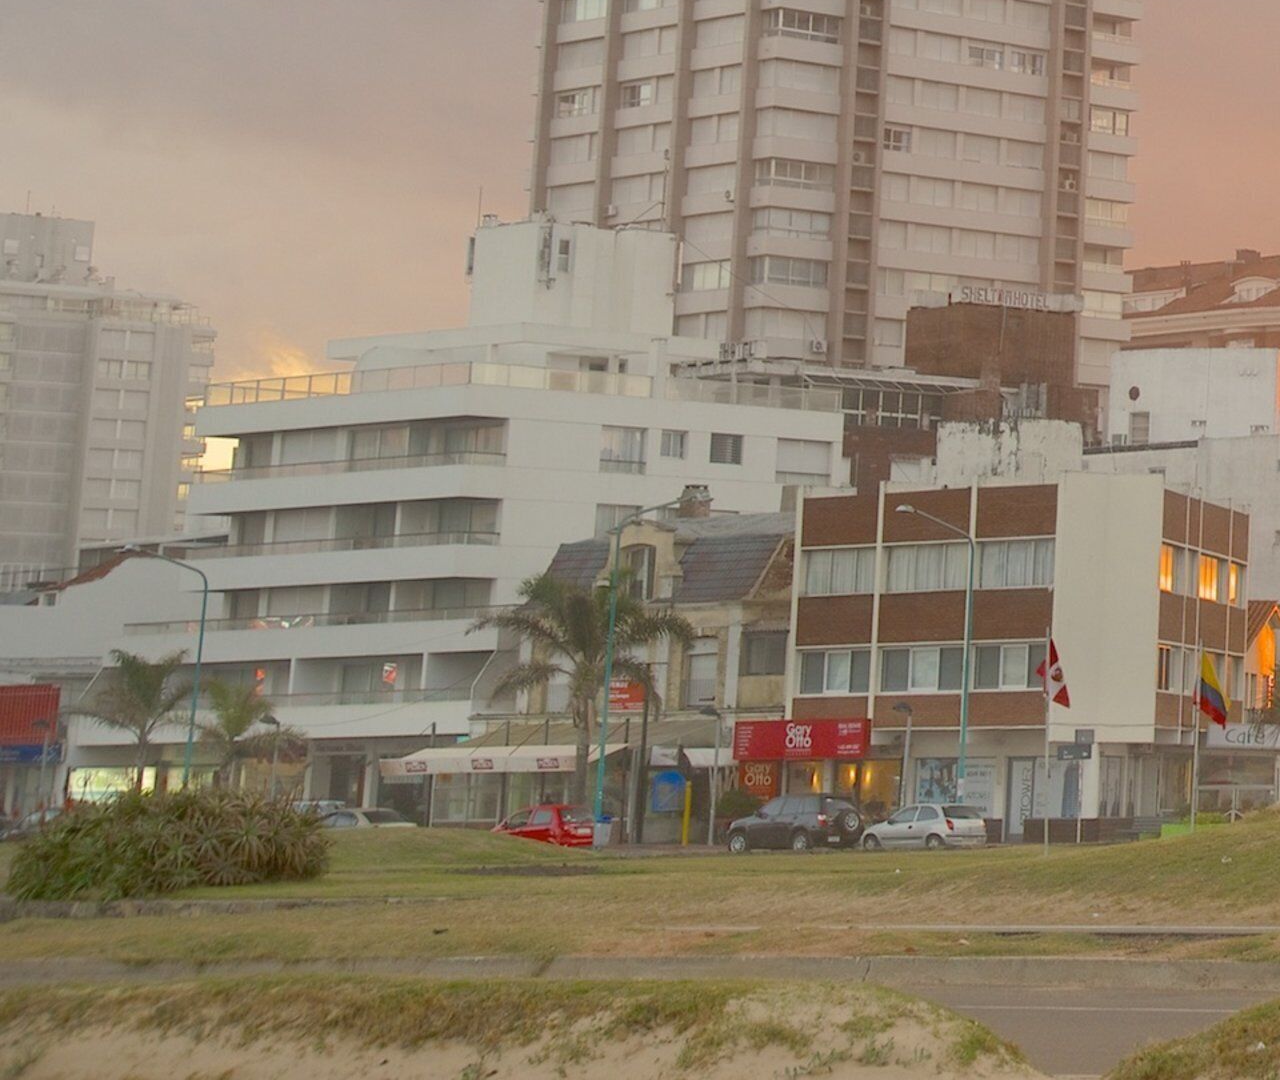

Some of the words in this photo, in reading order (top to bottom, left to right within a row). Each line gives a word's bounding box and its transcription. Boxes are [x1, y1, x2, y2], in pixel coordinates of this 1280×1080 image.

[1014, 290, 1051, 309] HOTEL
[785, 722, 812, 737] Gary
[785, 734, 812, 748] Otto
[744, 762, 772, 774] Gary
[744, 773, 772, 786] Otto
